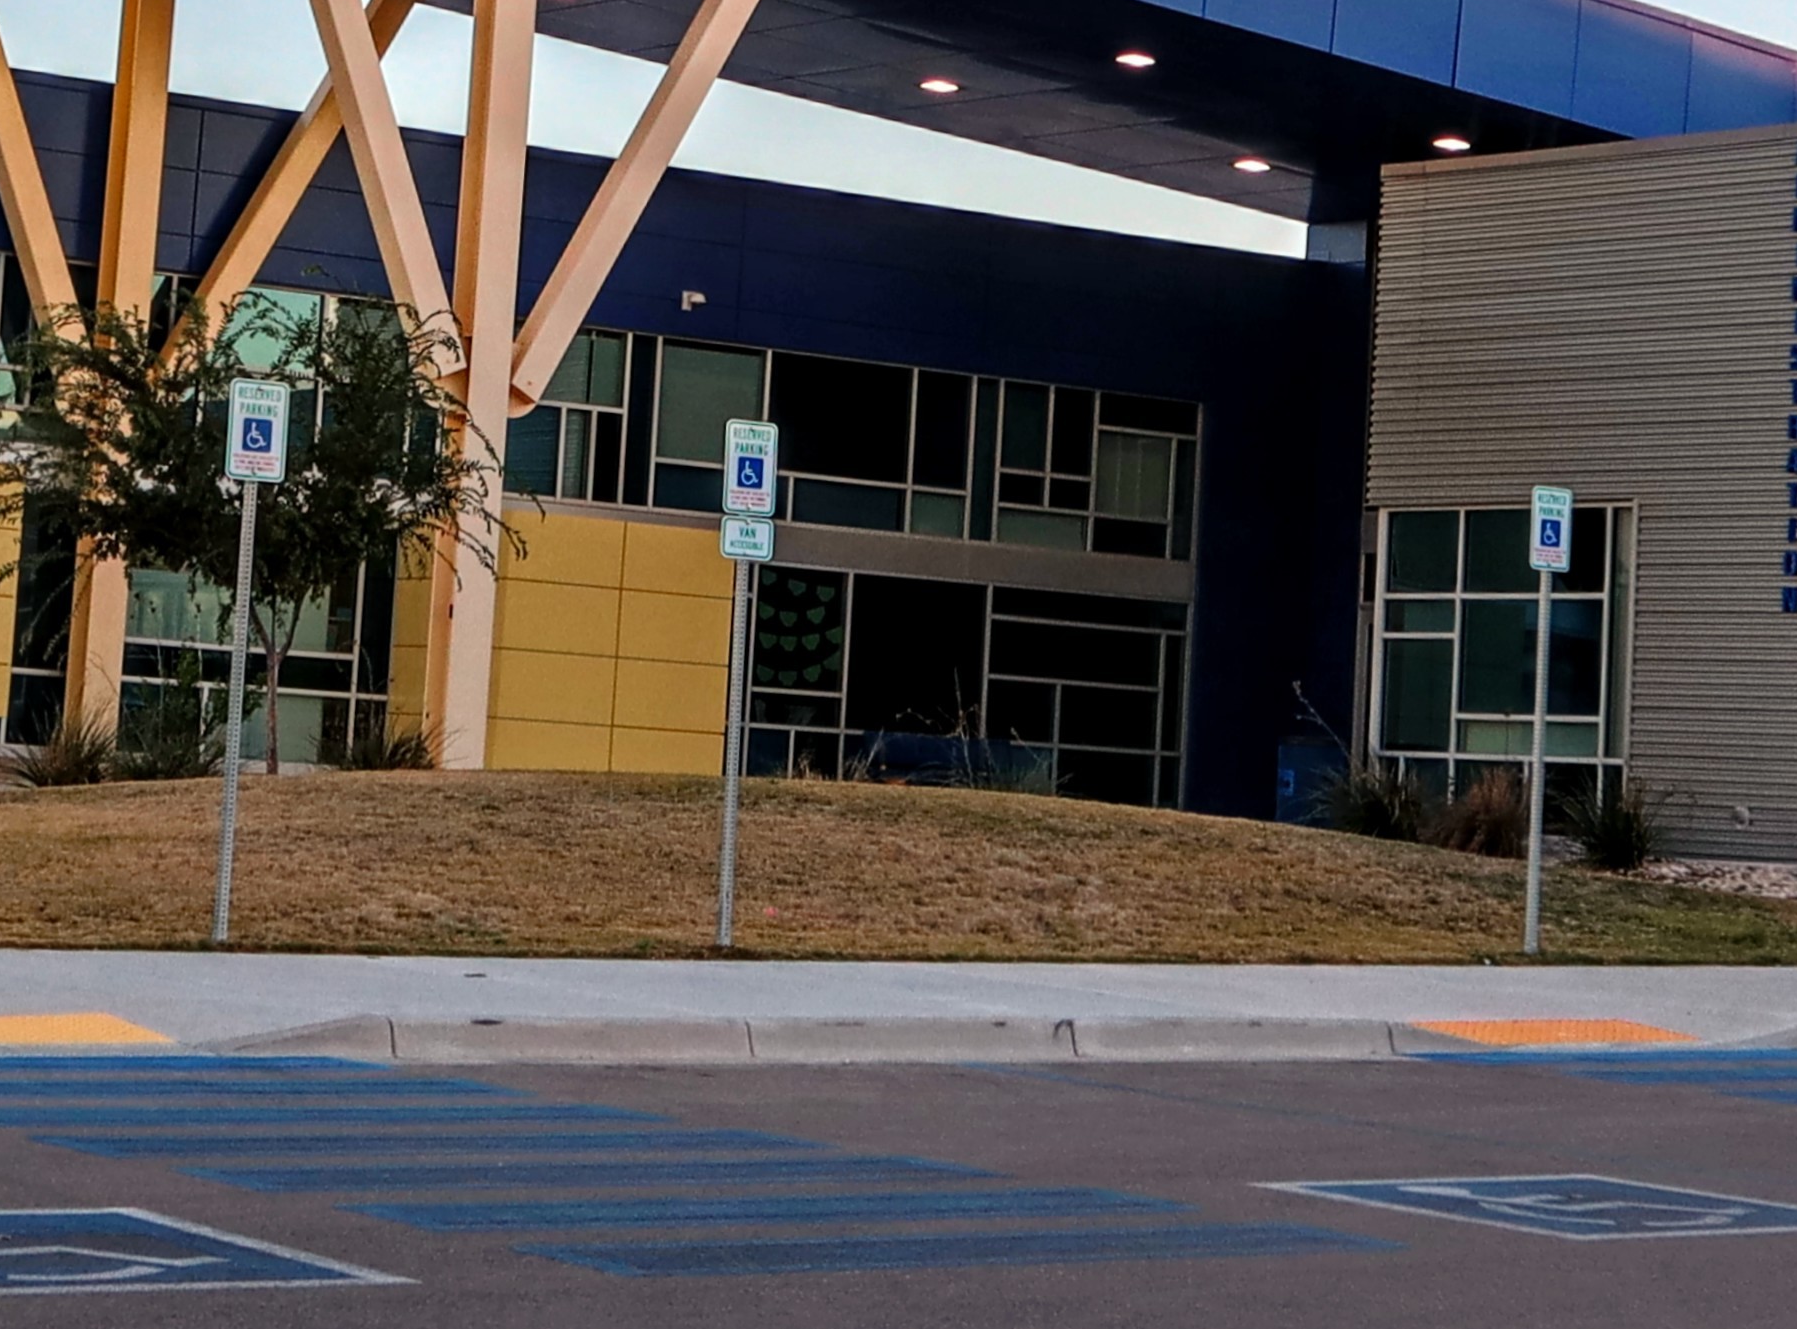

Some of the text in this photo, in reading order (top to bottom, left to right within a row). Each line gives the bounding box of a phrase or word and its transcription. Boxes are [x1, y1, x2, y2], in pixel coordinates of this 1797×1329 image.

[238, 386, 282, 403] RESERVED
[239, 402, 278, 418] PARKING
[733, 427, 771, 442] RESERVED
[734, 441, 769, 456] PARKING
[738, 526, 757, 539] VAN
